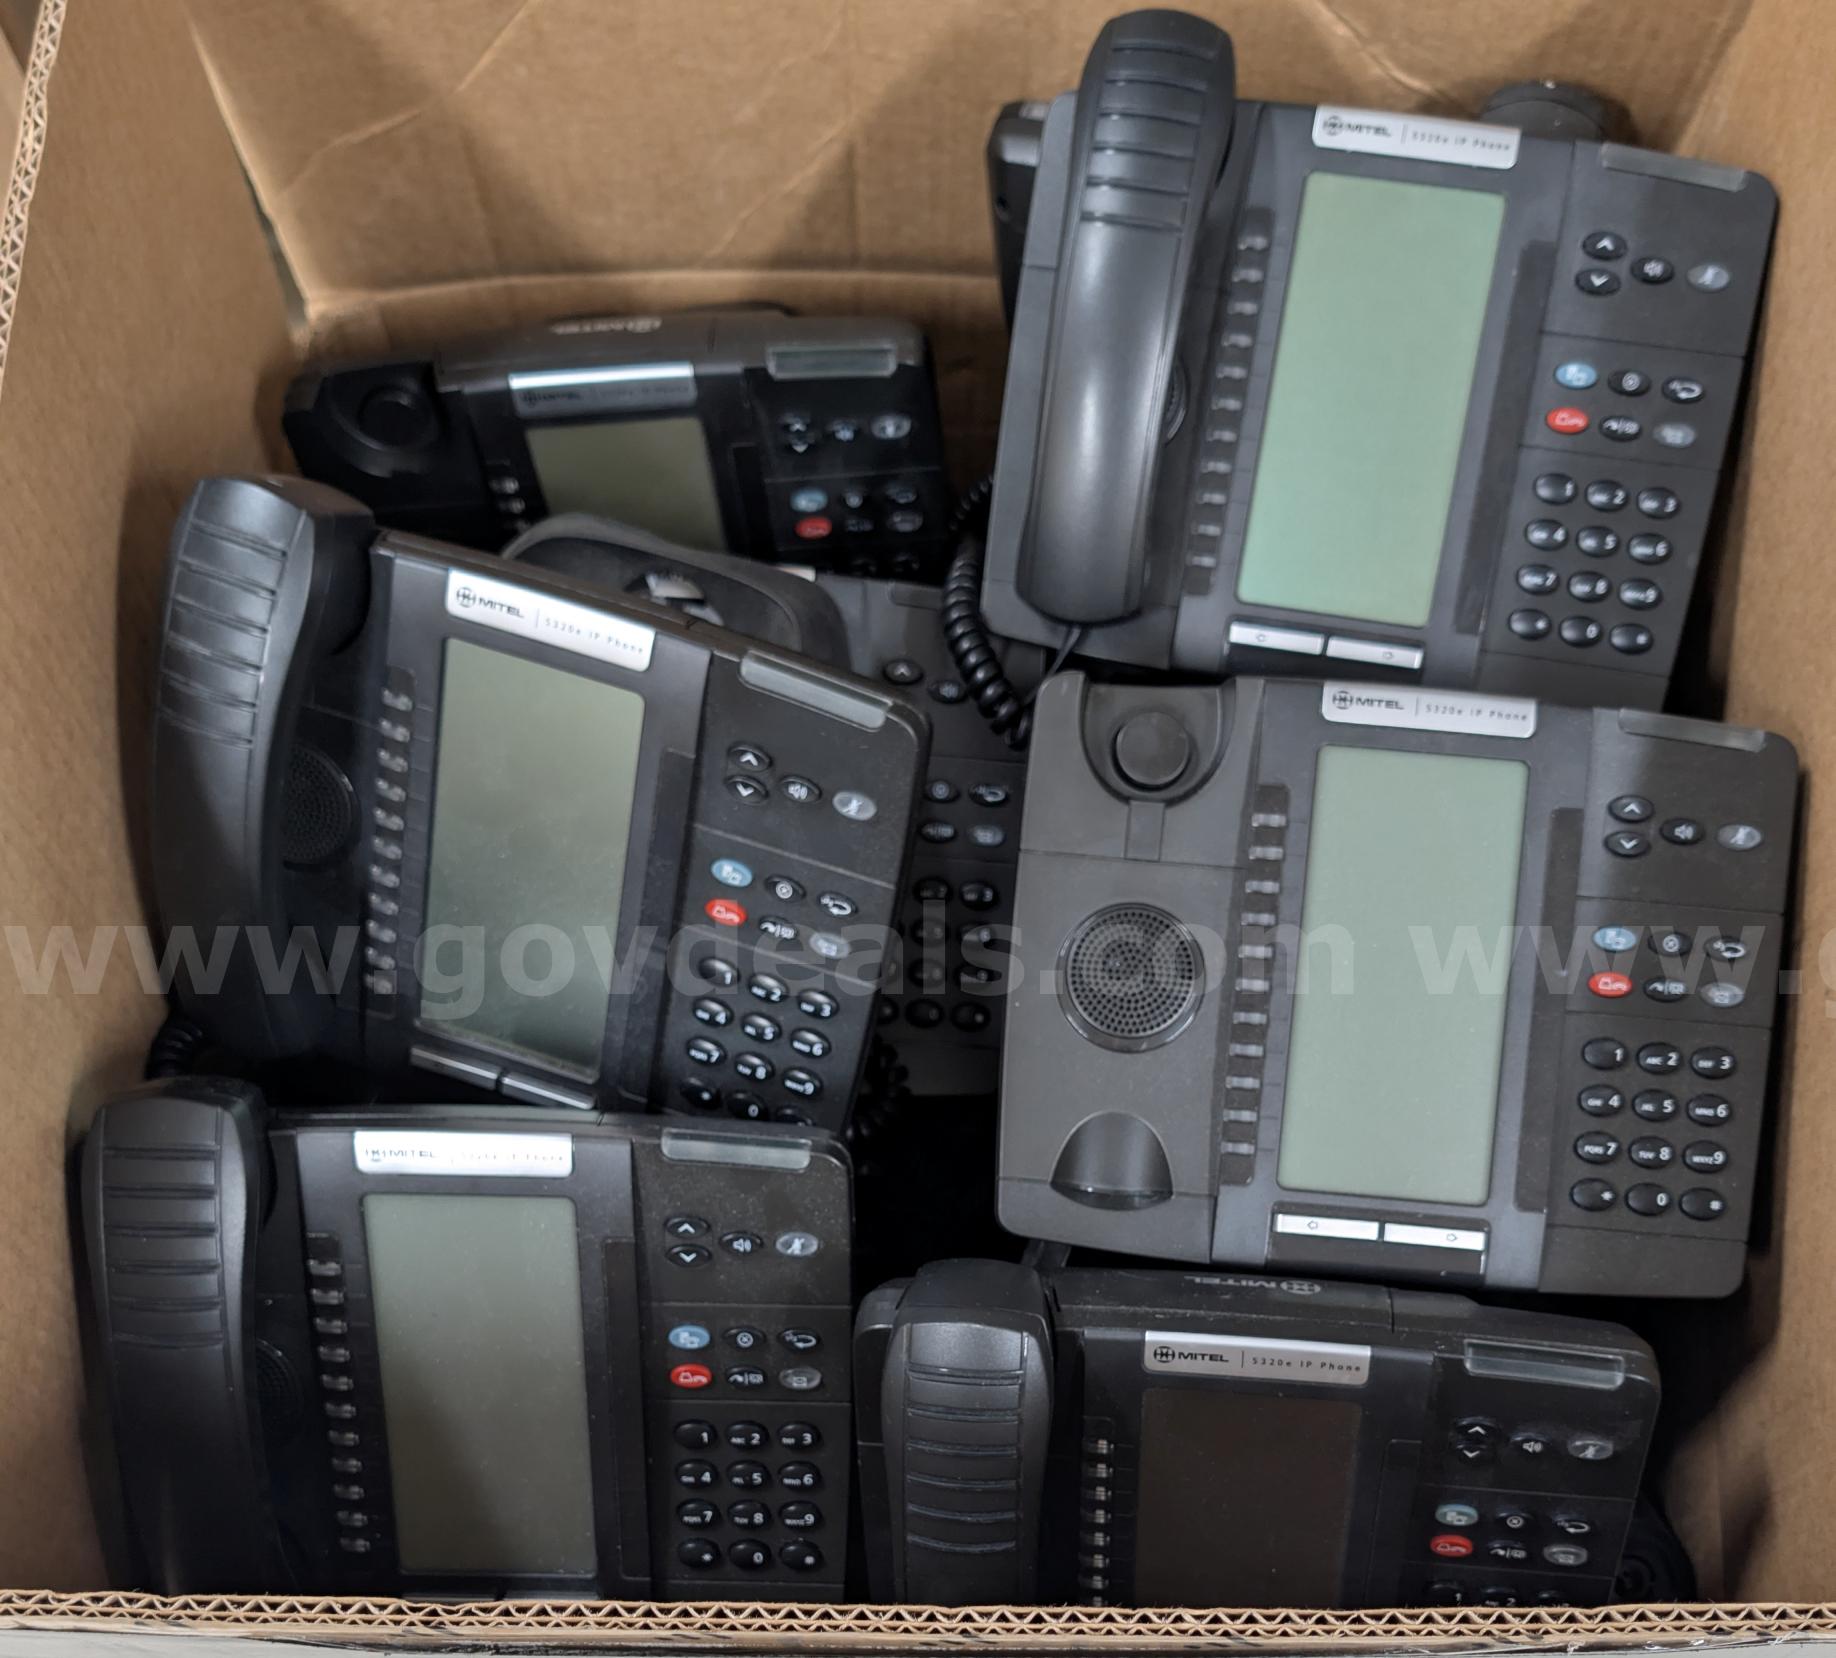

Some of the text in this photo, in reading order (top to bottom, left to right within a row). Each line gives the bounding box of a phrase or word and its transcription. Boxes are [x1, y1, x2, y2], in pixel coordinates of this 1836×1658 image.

[479, 597, 524, 618] MITEL
[1356, 697, 1404, 710] MITEL
[1489, 710, 1528, 722] Phone
[1614, 1048, 1625, 1062] 1
[1667, 1052, 1678, 1066] 2
[1720, 1056, 1731, 1070] 3
[1608, 1094, 1621, 1108] 4
[1663, 1099, 1675, 1113] 5
[1716, 1104, 1729, 1118] 6
[1606, 1142, 1618, 1155] 7
[1659, 1147, 1672, 1160] 8
[1713, 1151, 1725, 1164] 9
[1656, 1193, 1668, 1206] 0
[1184, 1275, 1276, 1289] MITEL
[1178, 1351, 1362, 1372] MITEL 5320e IP Phone
[701, 1432, 709, 1443] 1
[750, 1433, 760, 1445] 2
[802, 1433, 812, 1445] 3
[701, 1471, 712, 1483] 4
[752, 1472, 762, 1485] 5
[803, 1473, 813, 1486] 6
[703, 1510, 713, 1523] 7
[753, 1512, 763, 1525] 8
[804, 1514, 815, 1526] 9
[753, 1552, 763, 1565] 0
